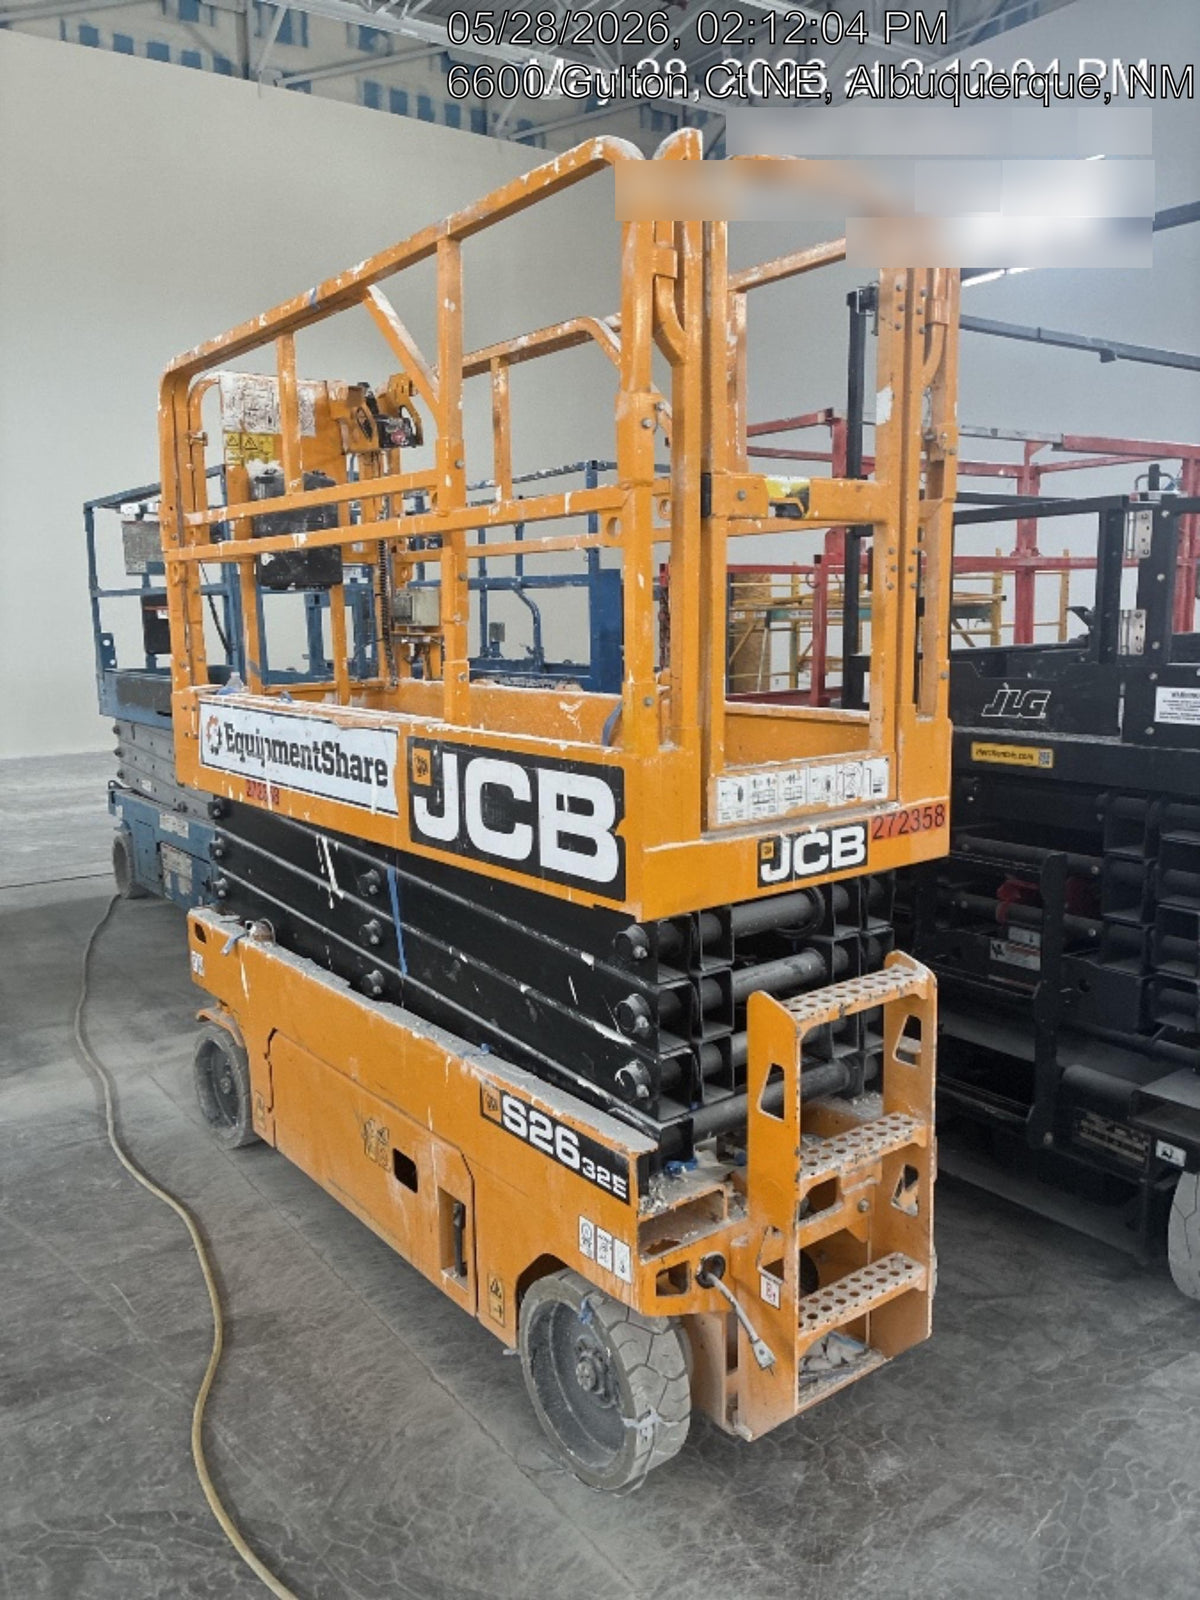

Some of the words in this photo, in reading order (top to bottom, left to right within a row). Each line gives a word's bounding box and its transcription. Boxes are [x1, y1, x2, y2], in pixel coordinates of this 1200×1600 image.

[980, 688, 1052, 719] JLG
[223, 721, 389, 788] EquipmentShare
[412, 751, 621, 884] JCB
[871, 803, 946, 841] 272358
[760, 825, 866, 882] JCB
